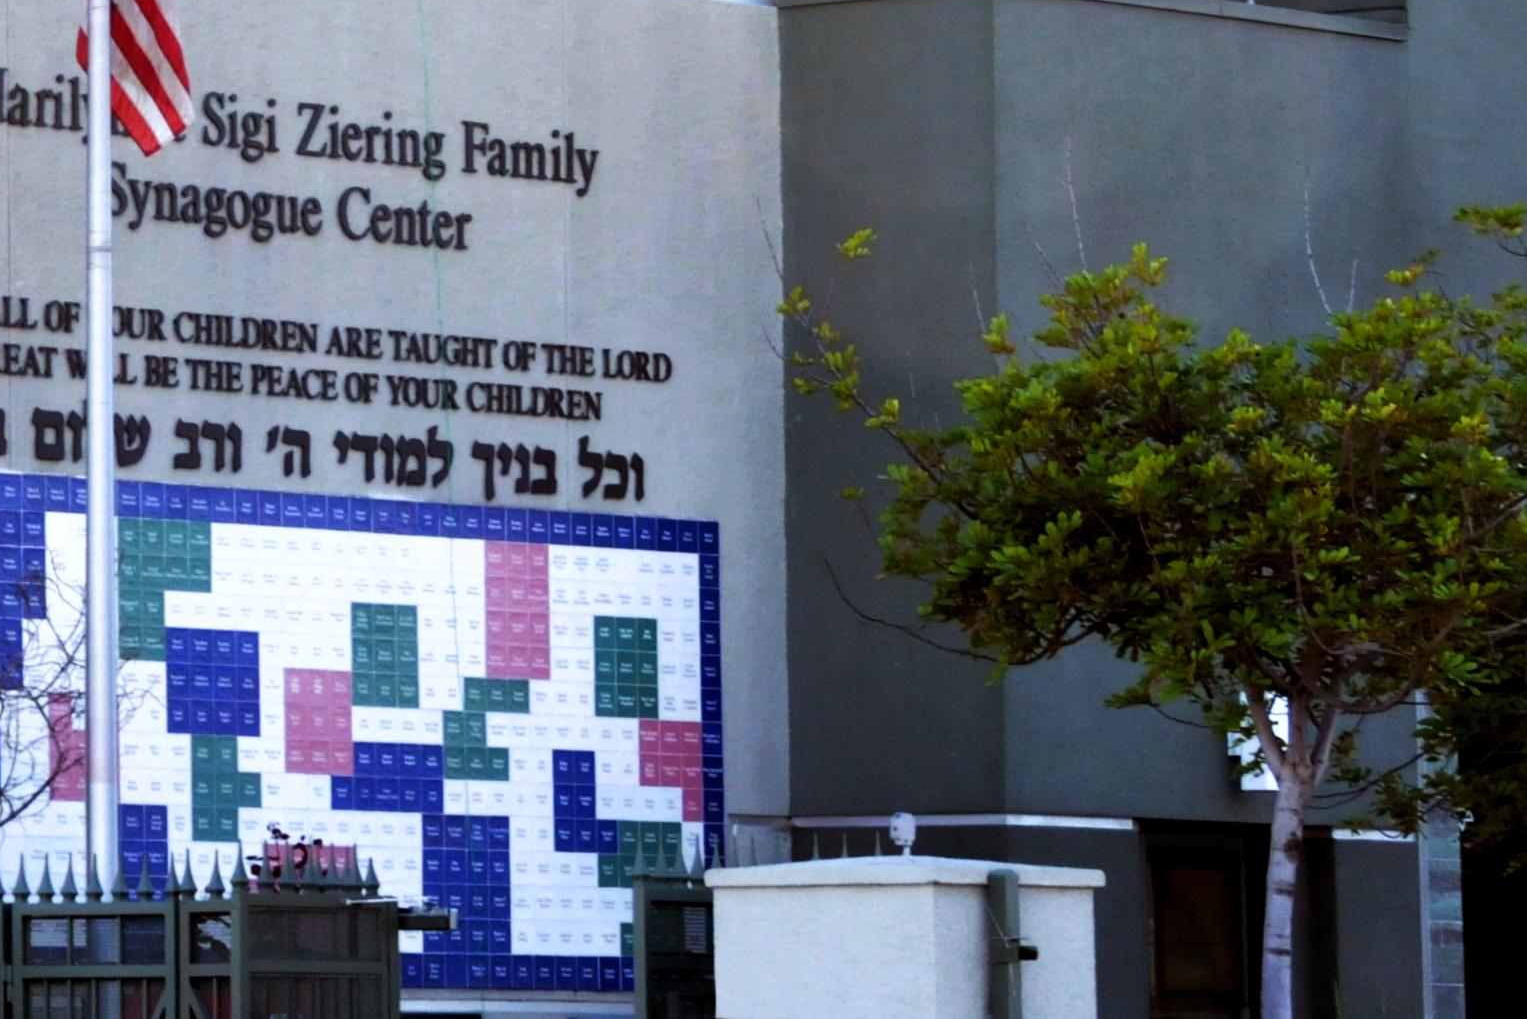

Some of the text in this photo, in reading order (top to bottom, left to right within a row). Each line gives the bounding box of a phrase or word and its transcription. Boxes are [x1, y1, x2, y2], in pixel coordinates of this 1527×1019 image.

[202, 91, 280, 164] Sigi
[295, 102, 446, 181] Ziering
[461, 119, 599, 198] Family
[111, 160, 474, 250] Synagogue Center
[44, 300, 80, 333] OF
[113, 305, 167, 342] OUR
[173, 312, 318, 353] CHILDREN
[325, 326, 383, 360] ARE
[388, 330, 497, 369] TAUGHT
[502, 341, 537, 373] OF
[542, 343, 595, 377] THE
[602, 348, 673, 383] LORD
[67, 348, 138, 385] WL
[145, 354, 179, 388] BE
[185, 358, 243, 393] THE
[251, 363, 337, 401] PEACE
[344, 372, 379, 403] OF
[387, 375, 459, 410] YOUR
[466, 382, 603, 421] CHILDREN
[32, 400, 151, 467] שום
[173, 418, 243, 473] ורב
[333, 425, 454, 487] למודי
[471, 440, 558, 502] בניך
[578, 435, 645, 501] וכל
